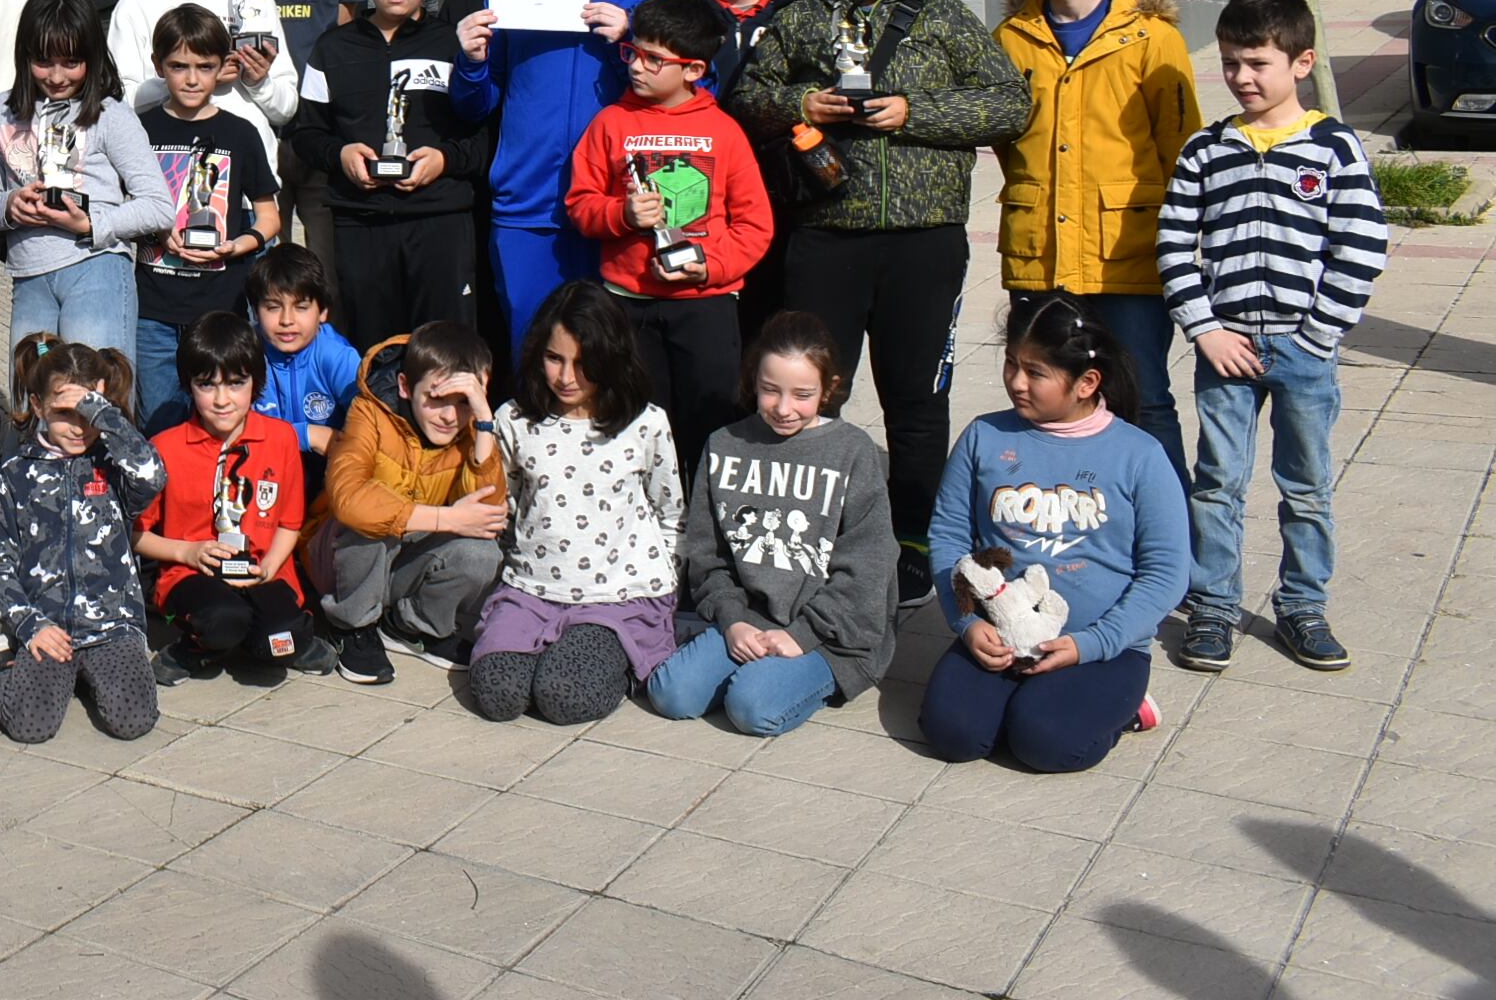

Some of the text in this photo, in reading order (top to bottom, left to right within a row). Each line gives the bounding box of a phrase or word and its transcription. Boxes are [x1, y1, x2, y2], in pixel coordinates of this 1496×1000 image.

[413, 78, 446, 88] adidas
[624, 135, 712, 152] MINECRAFT
[989, 482, 1109, 533] ROARR!
